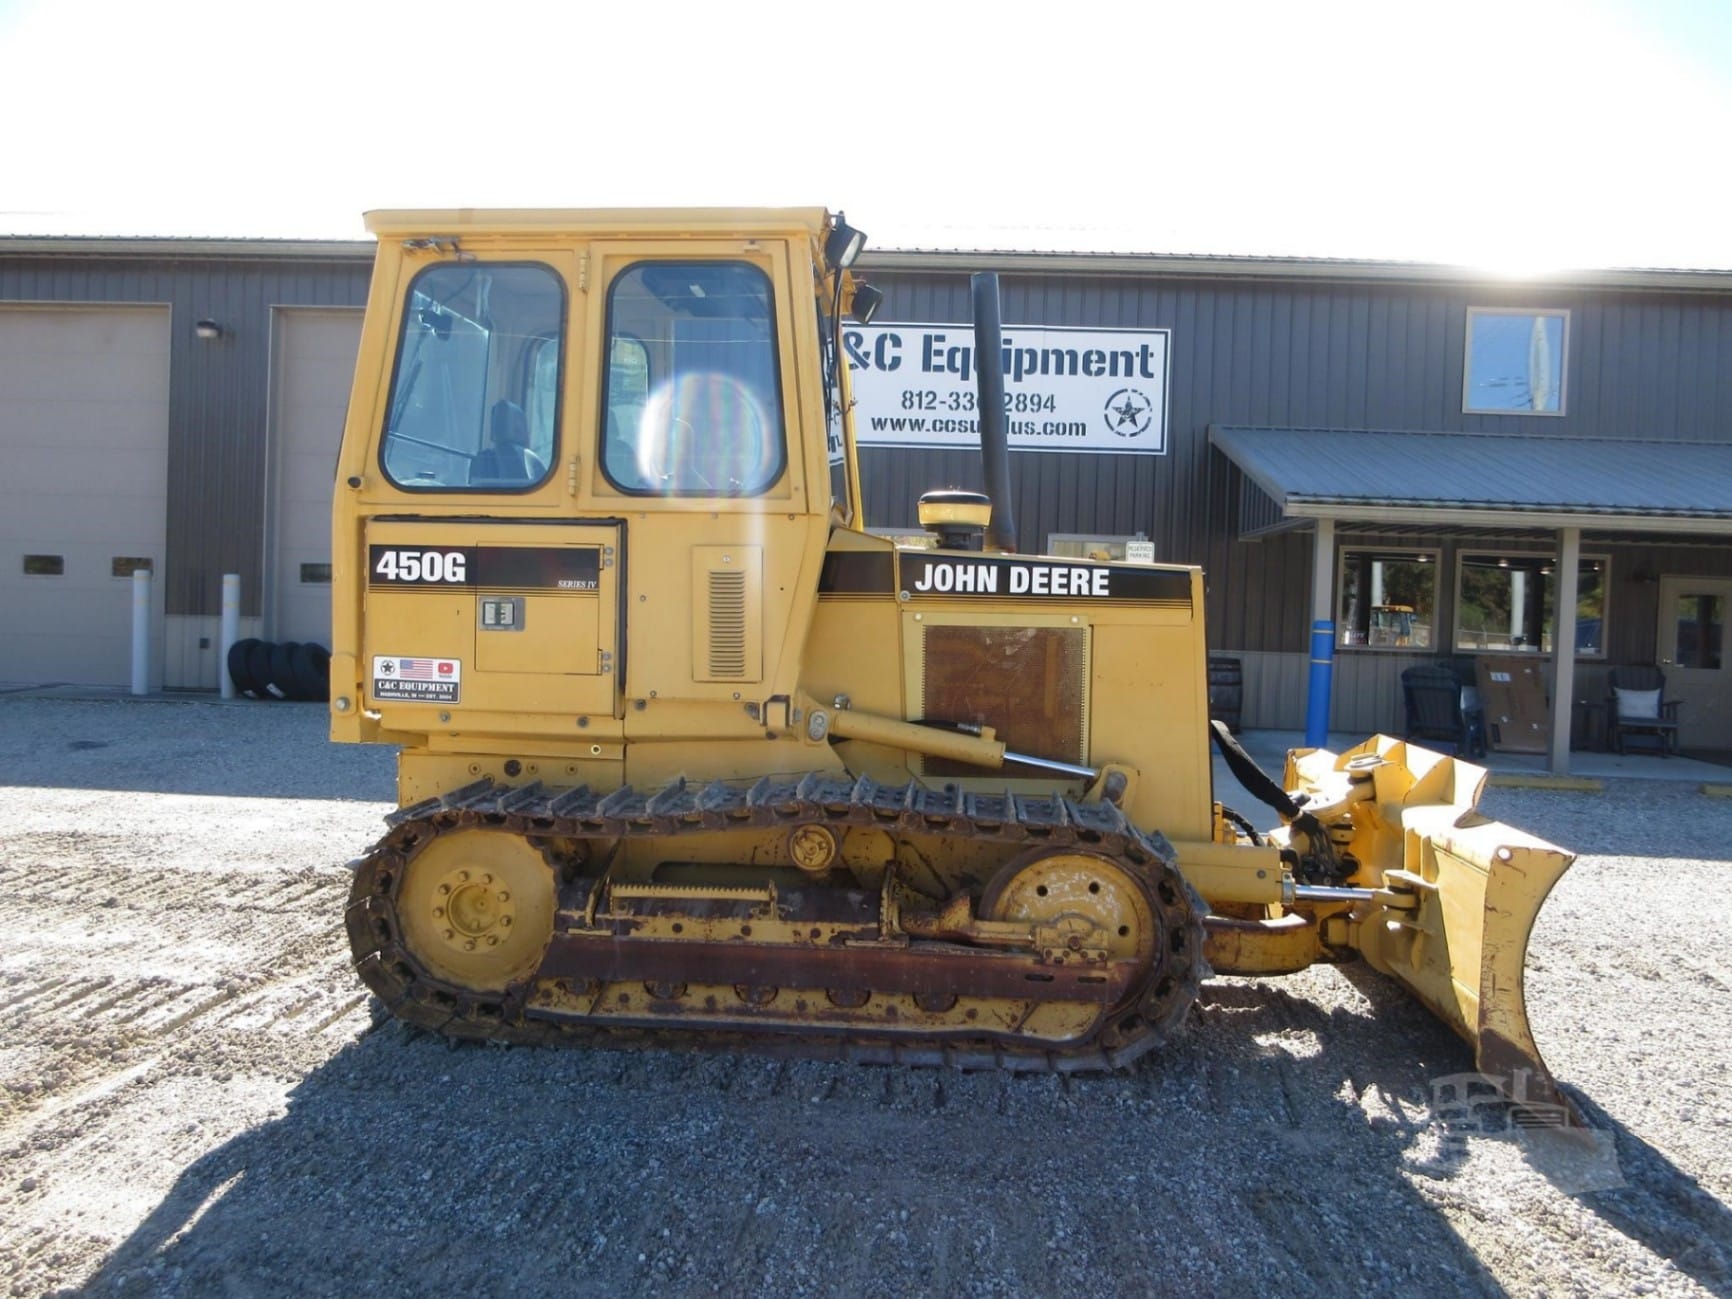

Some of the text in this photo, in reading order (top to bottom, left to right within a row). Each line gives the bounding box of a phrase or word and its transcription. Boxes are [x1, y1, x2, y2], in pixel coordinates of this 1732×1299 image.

[921, 334, 1154, 382] Eqipment
[902, 390, 1056, 414] 812-332894
[871, 415, 1087, 437] www.ccsulus.com
[376, 551, 466, 583] 450G
[558, 579, 586, 589] SERIES
[915, 563, 1110, 596] JOHN DEERE
[378, 680, 455, 693] C&C EQUIPMENT
